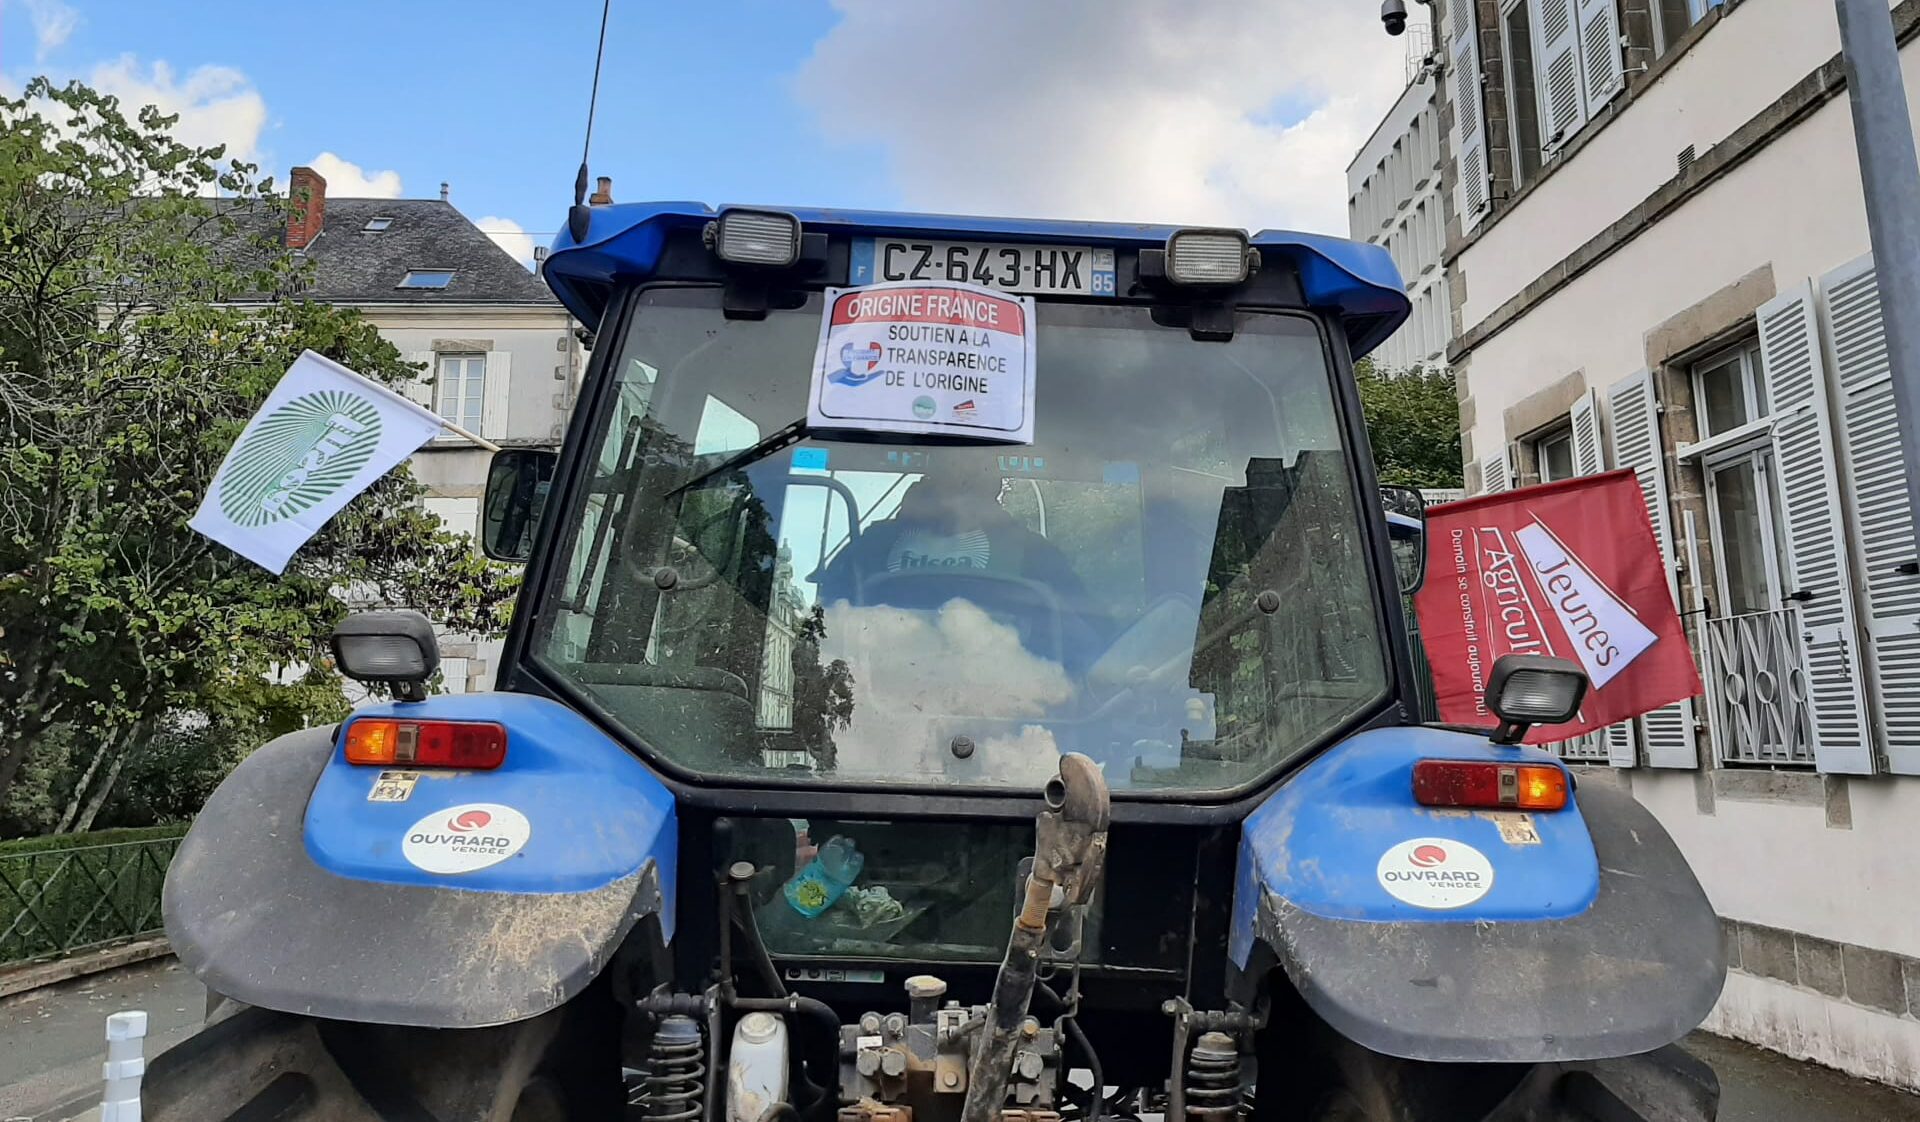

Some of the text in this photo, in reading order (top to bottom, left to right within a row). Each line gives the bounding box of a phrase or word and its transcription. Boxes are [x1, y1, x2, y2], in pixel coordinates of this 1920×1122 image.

[857, 265, 867, 278] F
[882, 243, 1083, 290] CZ-643-HX
[1092, 273, 1114, 292] 85
[847, 294, 998, 325] ORIGINE FRANCE
[888, 325, 954, 345] SOUTIEN
[972, 331, 991, 348] LA
[887, 347, 1007, 373] TRANSPARENCE
[885, 370, 988, 394] DE L'ORIGINE
[1451, 529, 1468, 573] Demain
[1457, 576, 1468, 590] se
[1460, 593, 1478, 641] construit
[1536, 557, 1620, 667] Jeunes
[410, 833, 511, 848] OUVRARD
[1384, 871, 1480, 882] OUVRARD
